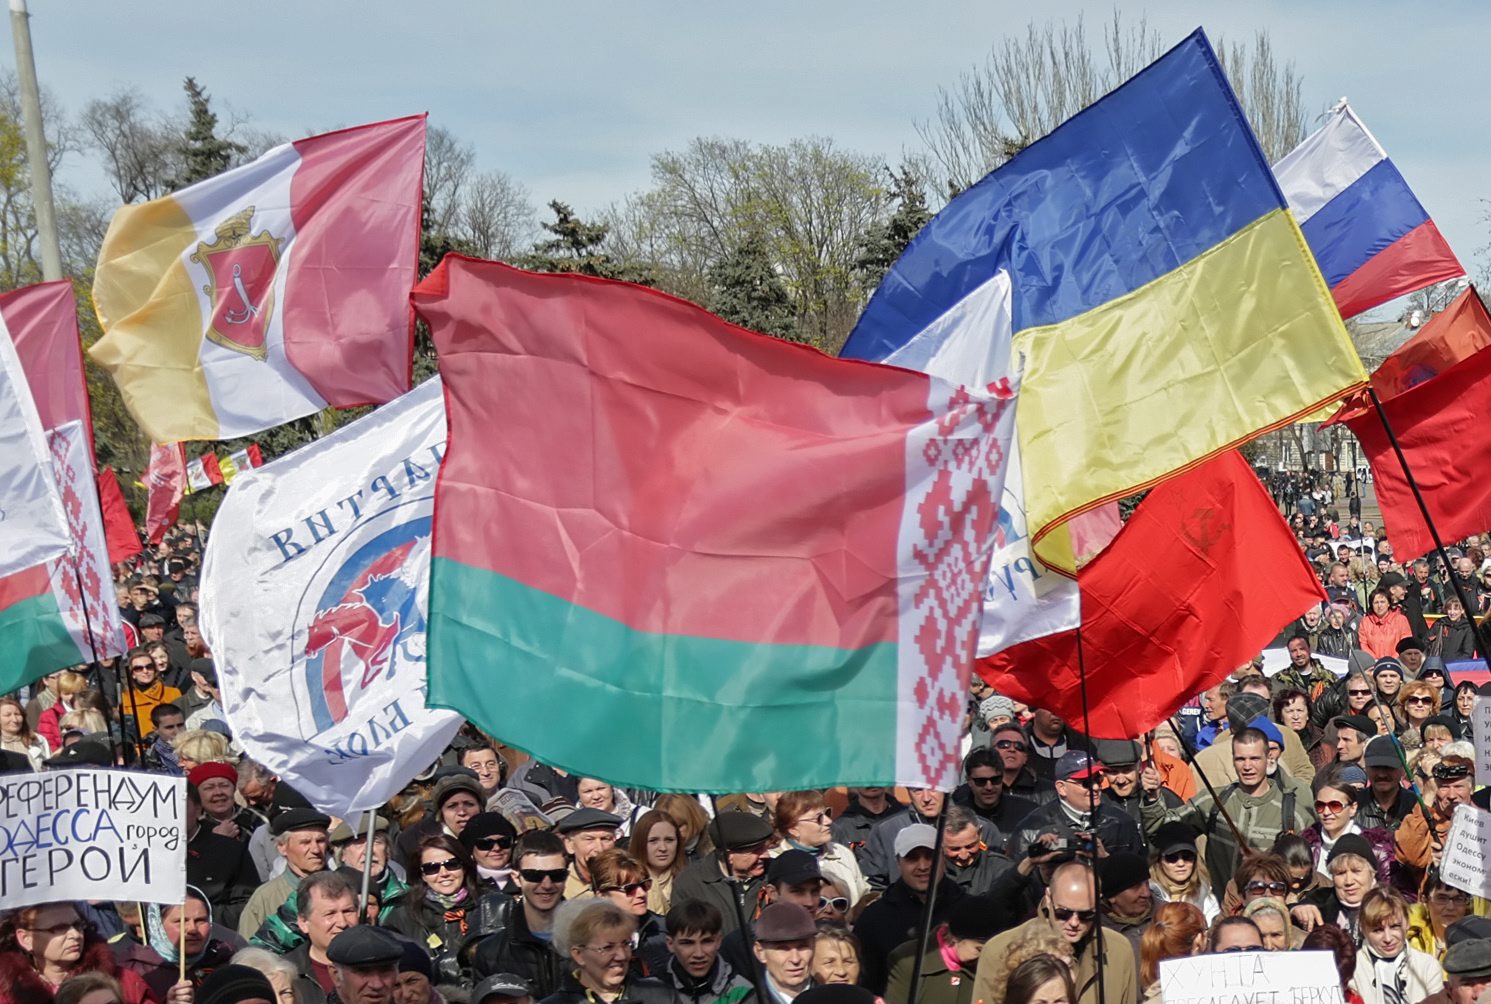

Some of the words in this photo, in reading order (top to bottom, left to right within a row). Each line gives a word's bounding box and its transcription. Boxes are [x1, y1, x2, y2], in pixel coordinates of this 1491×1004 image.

[1463, 813, 1485, 828] Киев
[127, 824, 179, 851] город
[1459, 830, 1488, 845] душит
[1456, 842, 1487, 860] Одессу
[1452, 858, 1487, 875] эконом
[1164, 954, 1270, 991] ХУНТА
